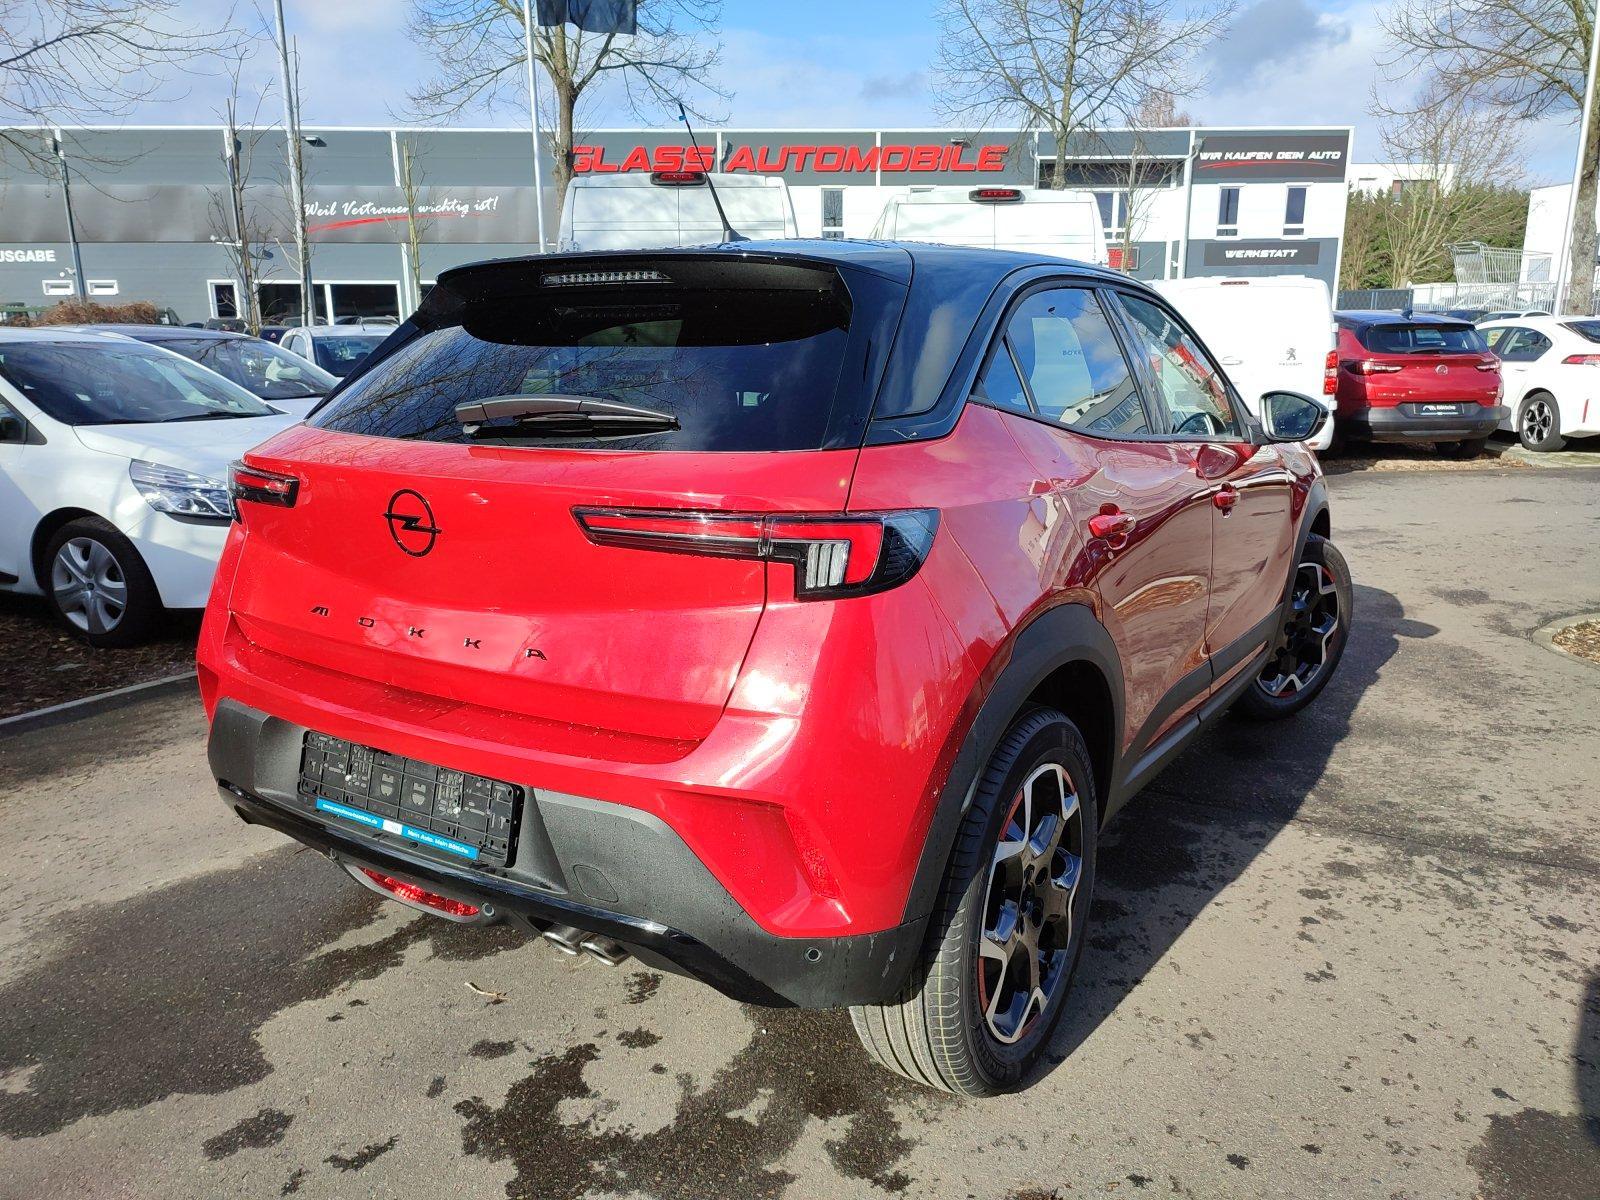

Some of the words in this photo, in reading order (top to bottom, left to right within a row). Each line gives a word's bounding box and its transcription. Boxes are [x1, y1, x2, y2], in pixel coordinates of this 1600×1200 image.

[572, 145, 715, 173] GLASS
[725, 145, 1009, 173] AUTOMOBILE
[1199, 151, 1222, 161] WIR
[1224, 151, 1273, 160] KAUFEN
[1276, 151, 1305, 160] DEIN
[1308, 151, 1341, 160] AUTO
[303, 199, 337, 216] Weil
[341, 200, 411, 216] Vertrauen
[418, 198, 470, 218] wichtig
[473, 196, 500, 211] ist!
[1225, 249, 1298, 259] WERKSTATT
[310, 605, 548, 662] MOKKA
